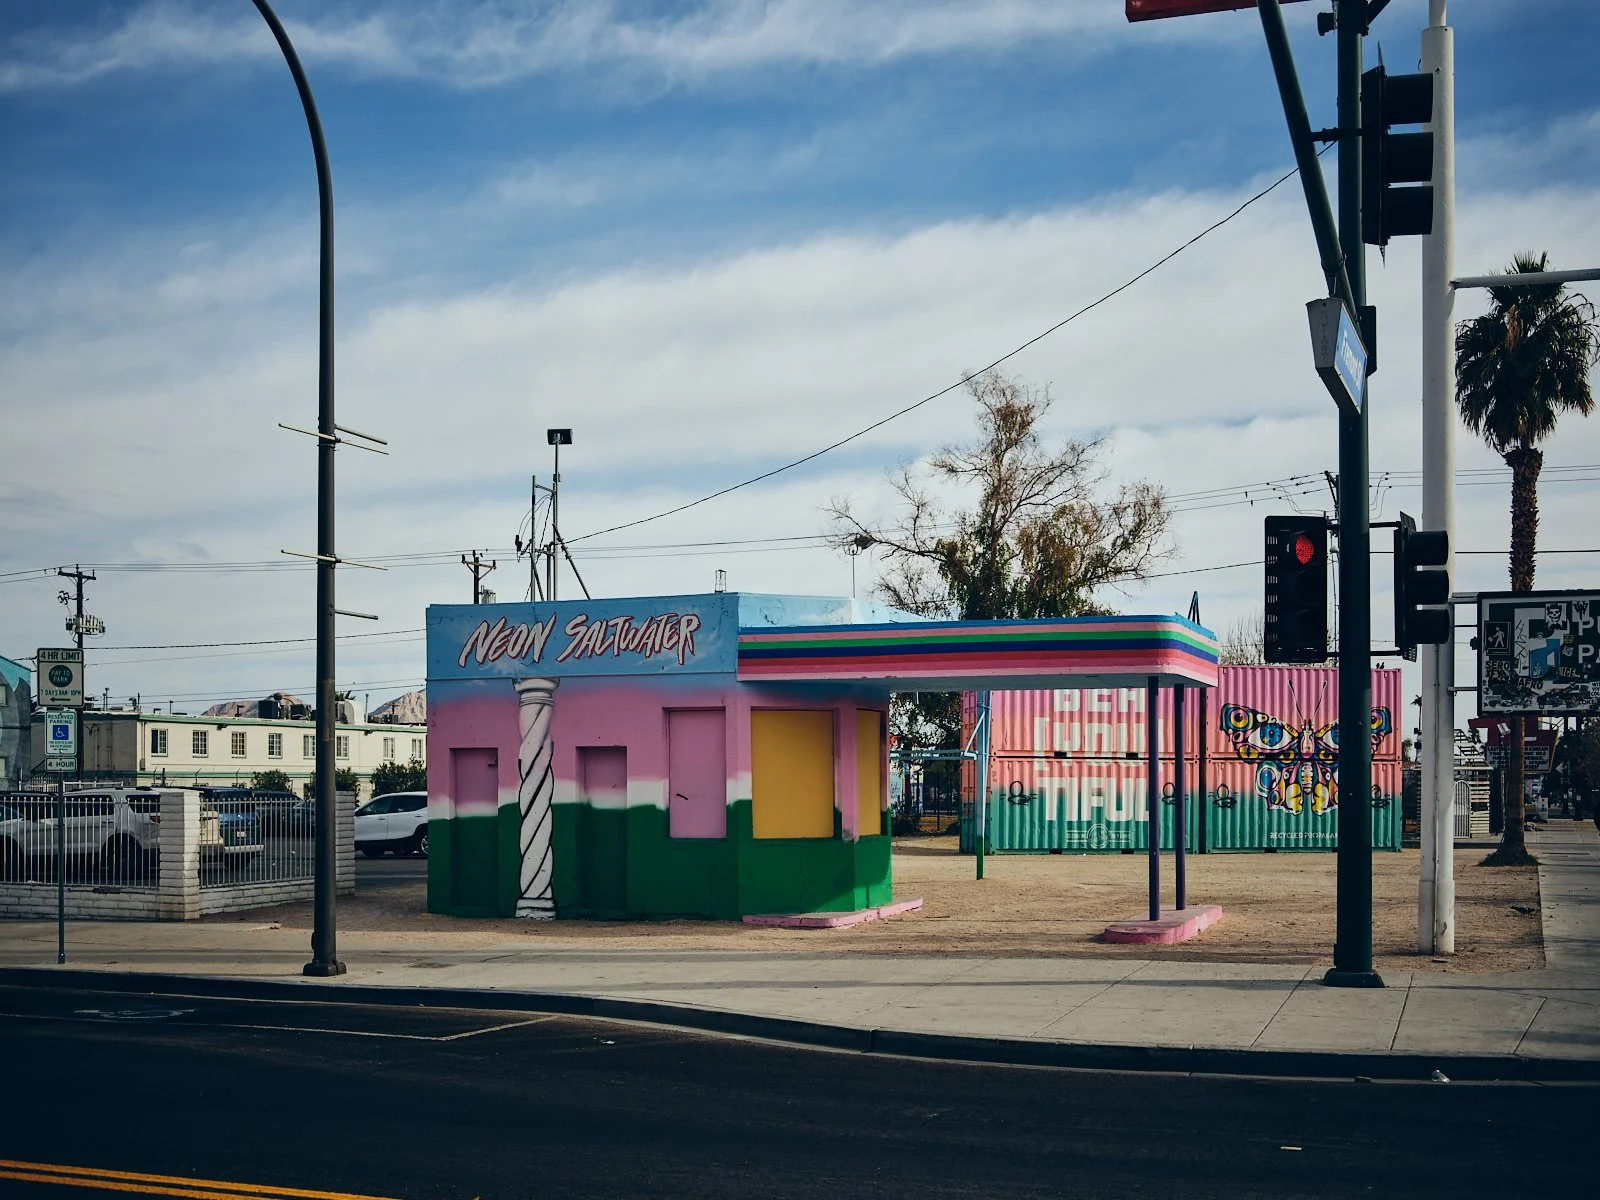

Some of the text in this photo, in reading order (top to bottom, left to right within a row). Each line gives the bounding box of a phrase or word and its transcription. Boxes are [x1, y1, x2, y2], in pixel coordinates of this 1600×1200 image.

[458, 611, 701, 668] NEON SALTWATER
[40, 651, 81, 661] 4 HR LIMIT
[1269, 831, 1304, 840] RECYCLED
